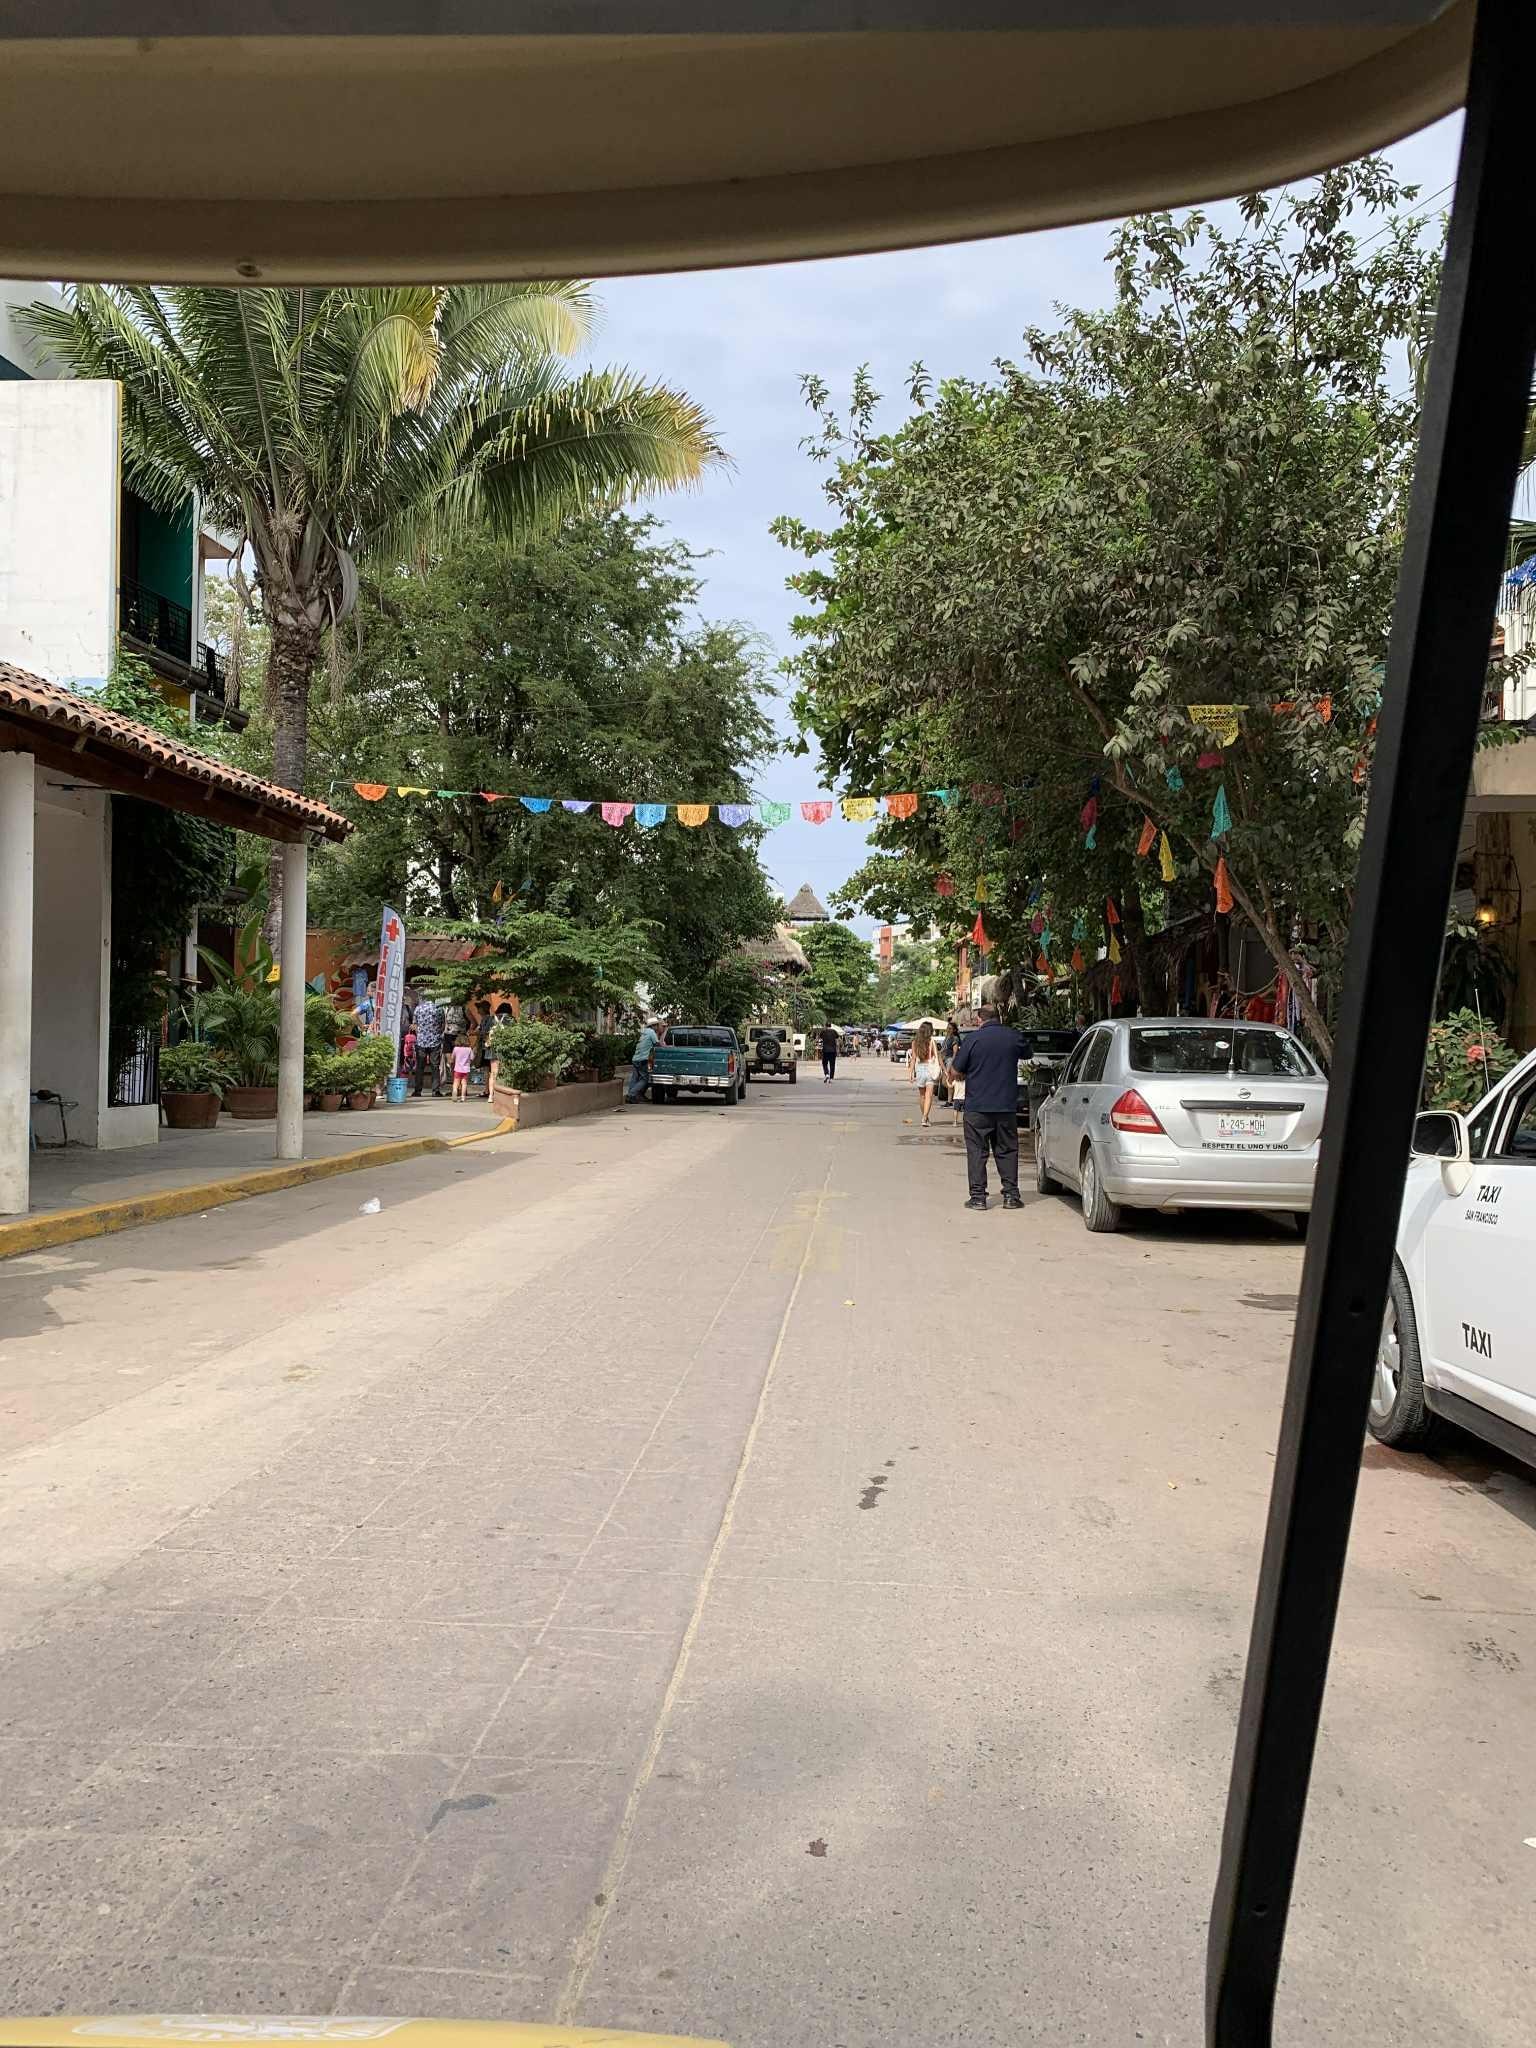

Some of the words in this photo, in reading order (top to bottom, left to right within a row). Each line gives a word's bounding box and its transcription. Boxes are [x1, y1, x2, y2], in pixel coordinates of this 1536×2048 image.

[1477, 1185, 1502, 1203] TAXI
[1465, 1209, 1474, 1220] SAN
[1474, 1211, 1498, 1225] FRANCISCO
[1462, 1322, 1492, 1359] TAXI
